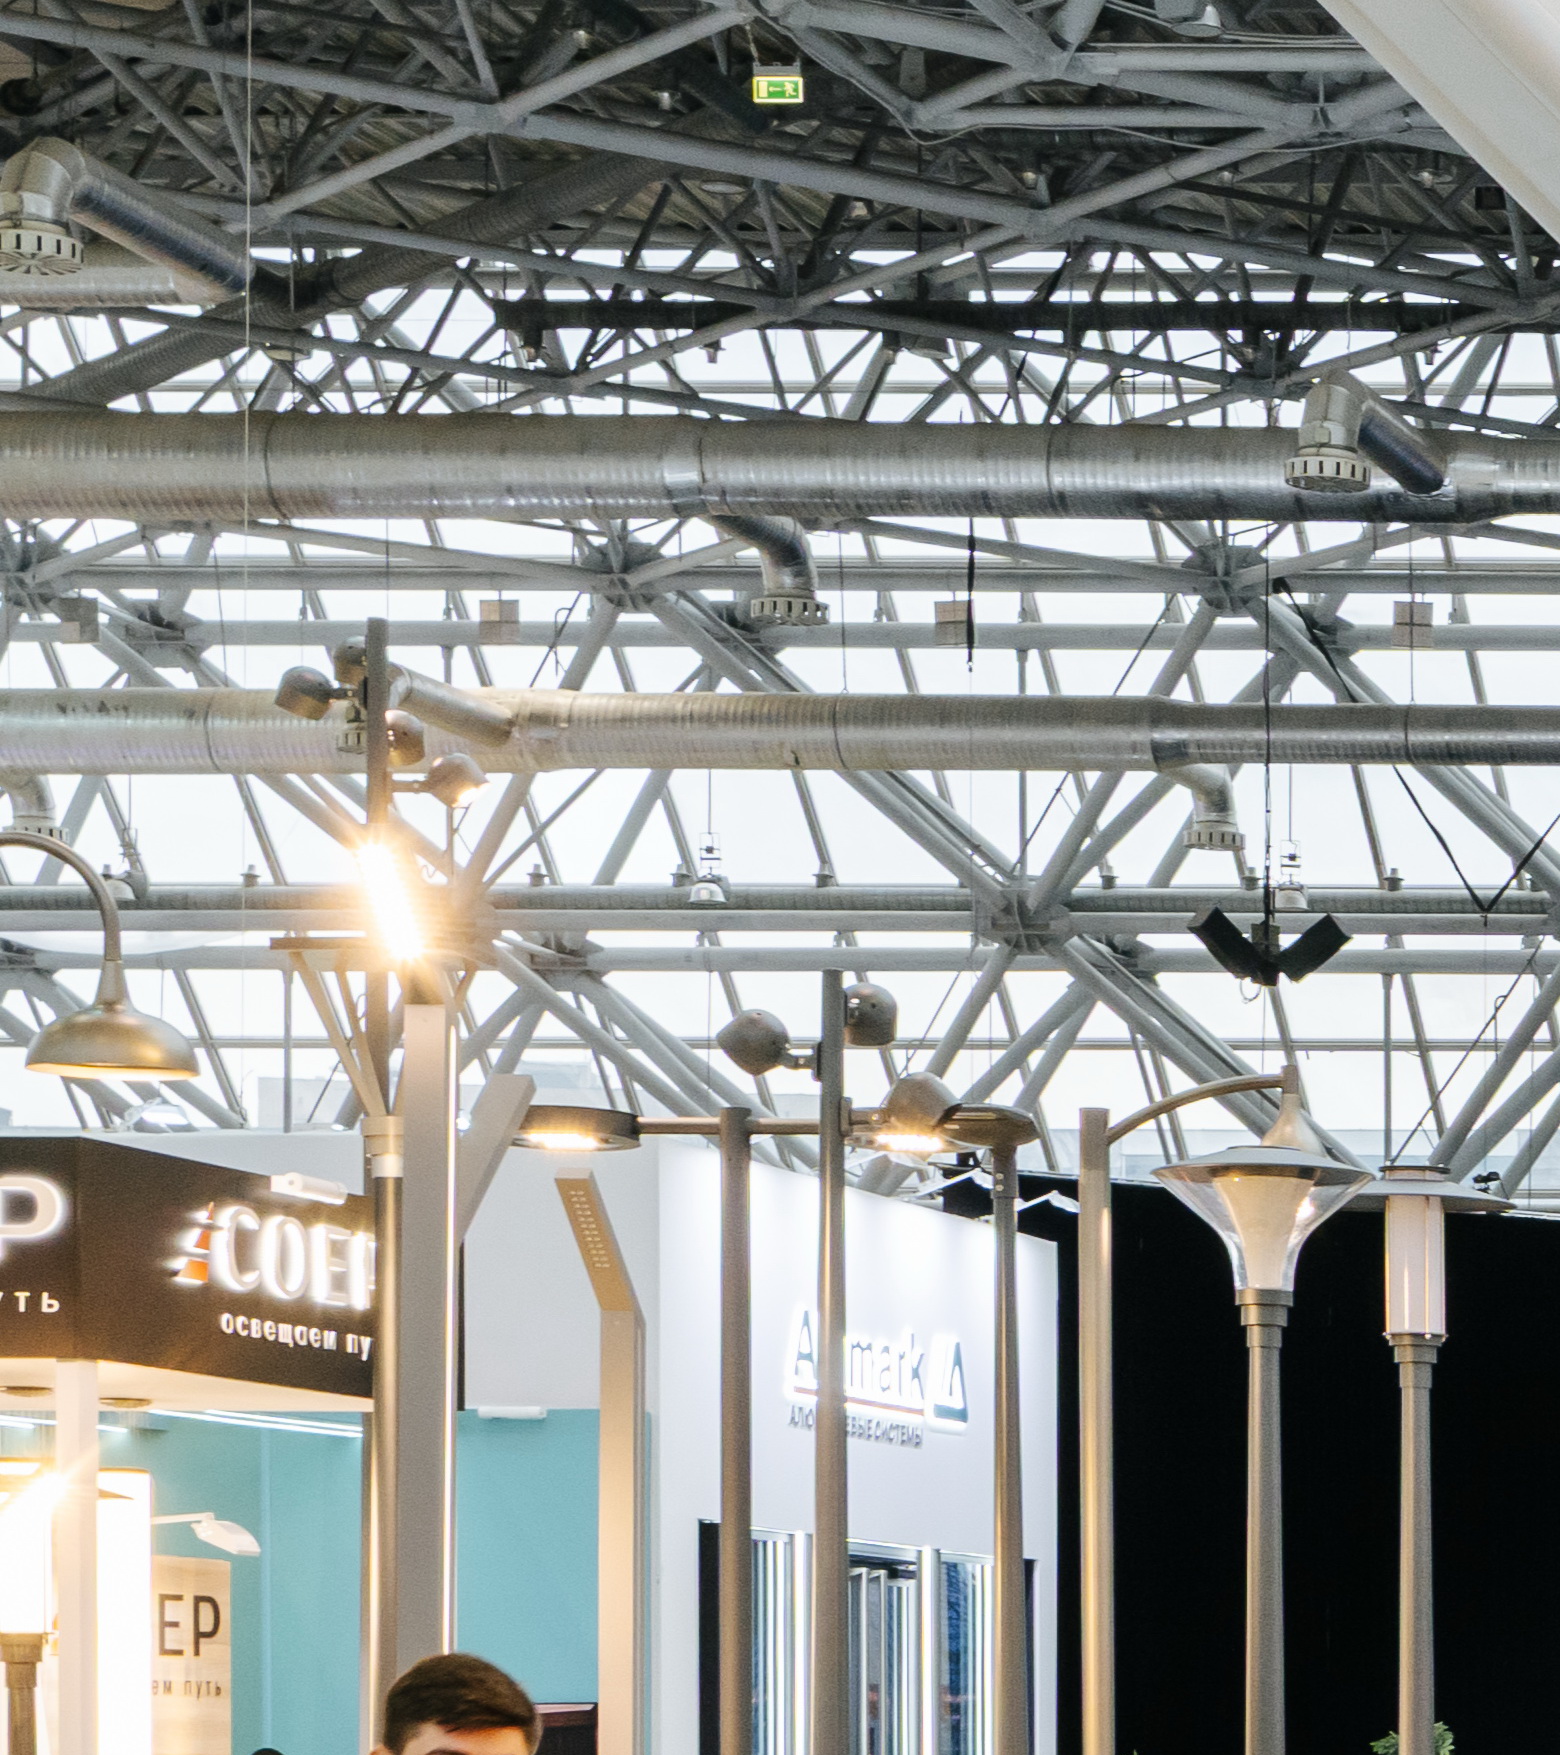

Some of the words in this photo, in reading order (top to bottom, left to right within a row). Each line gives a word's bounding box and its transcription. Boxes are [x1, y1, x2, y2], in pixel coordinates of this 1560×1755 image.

[220, 1311, 338, 1351] освещаем
[345, 1332, 372, 1361] пу
[793, 1309, 925, 1401] Amark
[787, 1404, 873, 1442] АЛЮЕВЫЕ
[157, 1593, 221, 1657] ЕР
